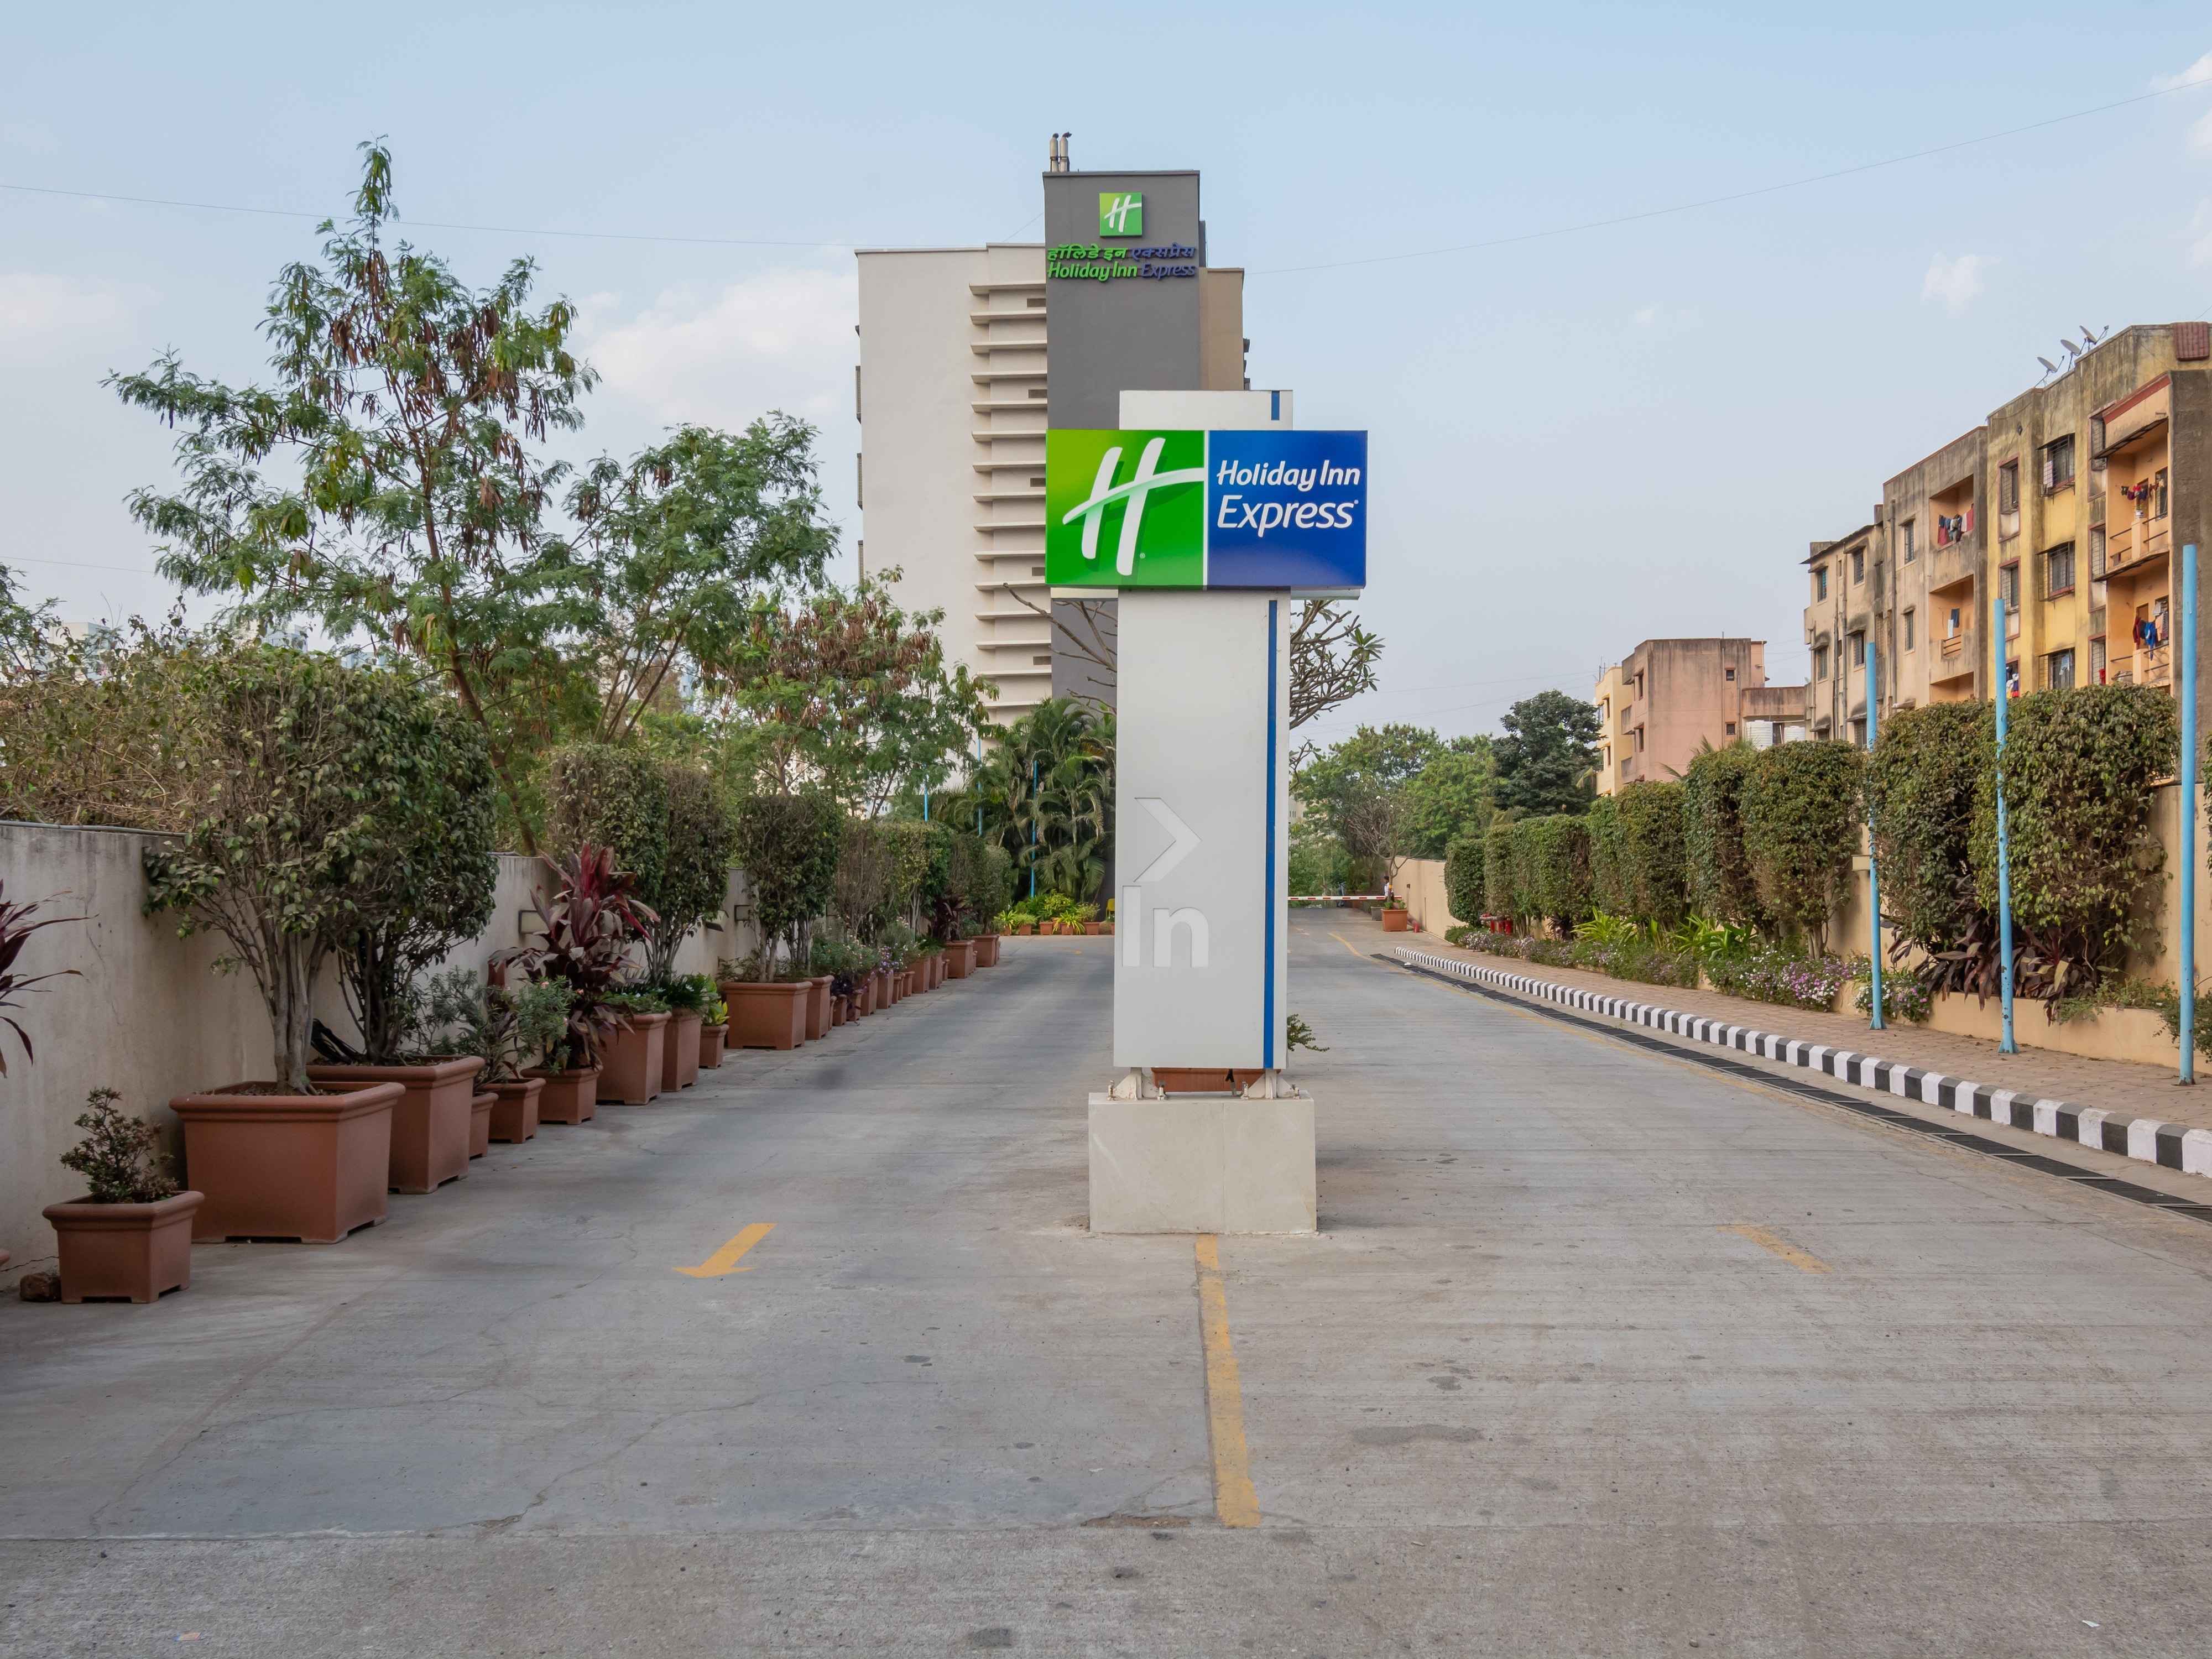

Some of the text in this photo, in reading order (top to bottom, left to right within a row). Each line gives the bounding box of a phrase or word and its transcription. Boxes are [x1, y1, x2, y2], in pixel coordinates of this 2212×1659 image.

[1047, 242, 1196, 261] हॉलिडे इन एक्सप्रेस
[1047, 261, 1196, 281] Holiday Inn Express
[1217, 460, 1360, 492] Holiday Inn
[1062, 437, 1204, 576] H
[1217, 495, 1355, 538] Express
[1121, 885, 1209, 968] In
